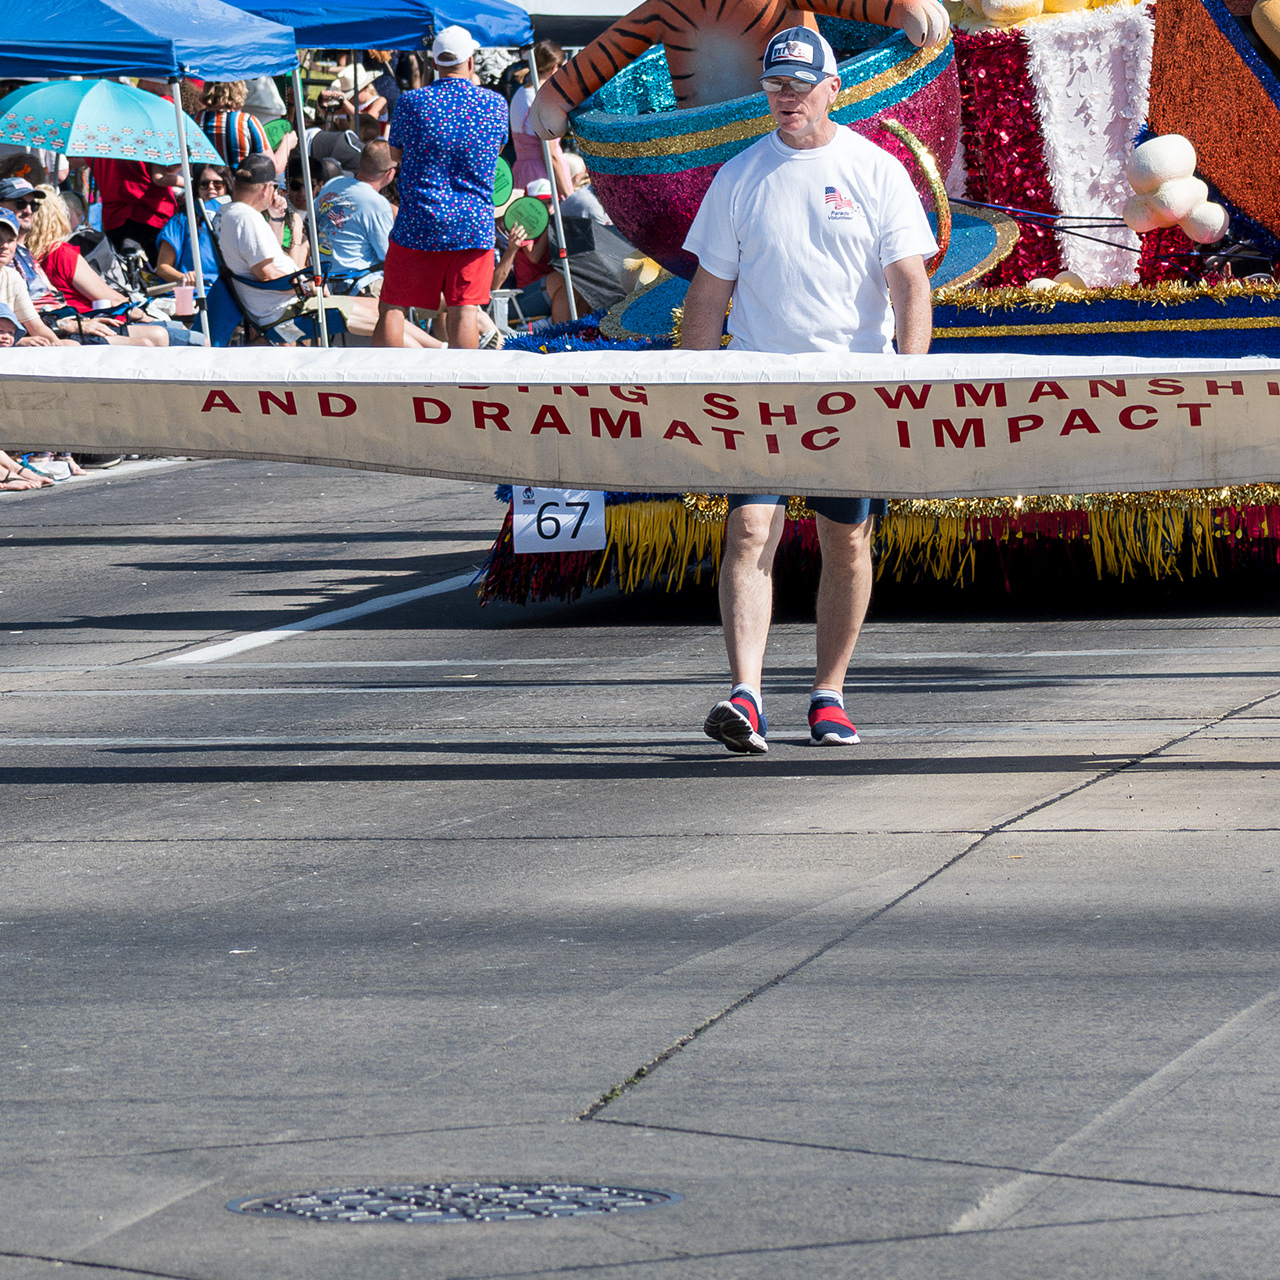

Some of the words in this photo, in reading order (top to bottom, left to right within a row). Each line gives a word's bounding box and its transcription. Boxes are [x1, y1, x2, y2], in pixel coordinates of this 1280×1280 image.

[200, 389, 358, 418] AND
[411, 396, 842, 455] DRAMATIC
[895, 402, 1213, 449] IMPACT
[536, 501, 590, 540] 67
